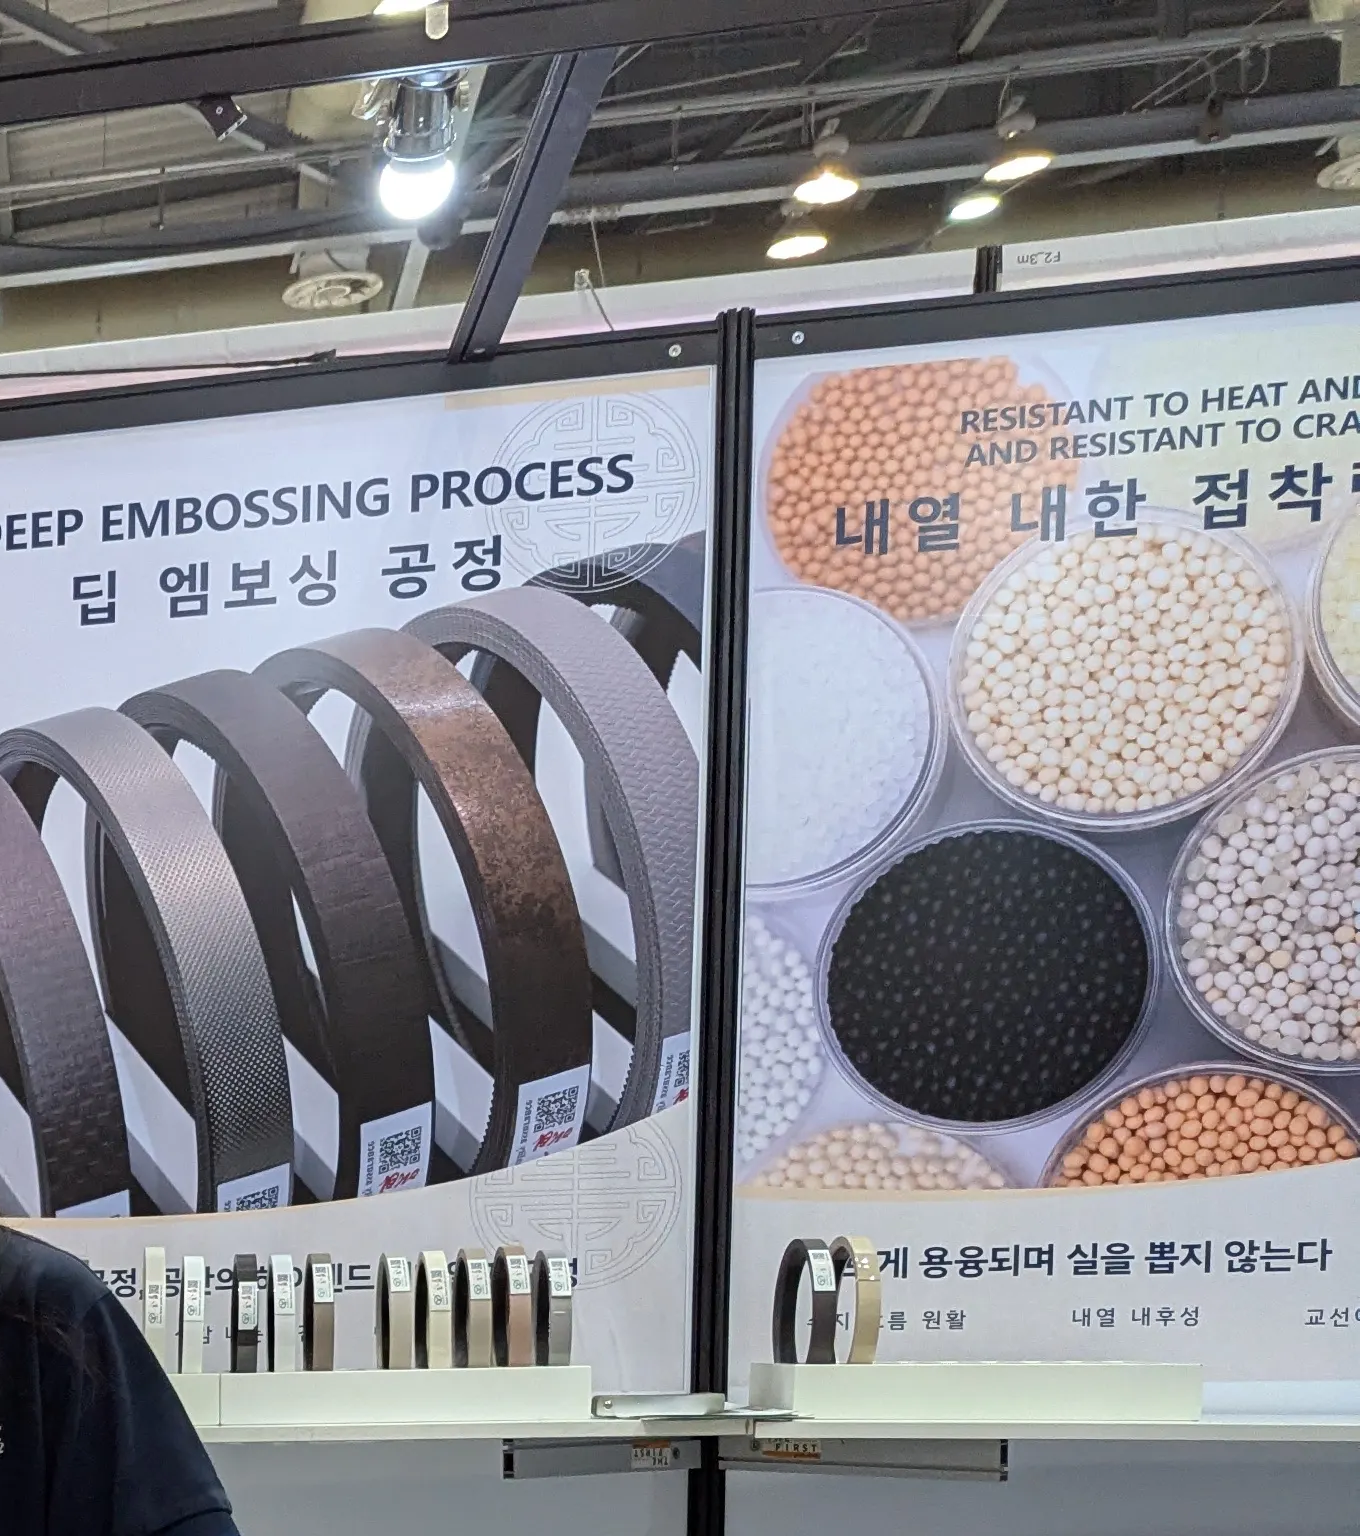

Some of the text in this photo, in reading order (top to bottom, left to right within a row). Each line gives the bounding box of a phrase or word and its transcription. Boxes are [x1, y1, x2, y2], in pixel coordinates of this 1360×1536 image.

[1016, 250, 1061, 267] F2_3m
[961, 396, 1134, 435] RESISTANT
[1147, 391, 1189, 417] TO
[1201, 381, 1289, 413] HEAT
[964, 439, 1039, 469] AND
[1050, 421, 1226, 461] RESISTANT
[1236, 417, 1282, 445] TO
[101, 477, 390, 543] EMBOSSING
[409, 453, 635, 514] PROCESS
[835, 461, 1360, 556] 내열 내한 접착
[70, 533, 505, 627] 딥 엠보싱 공정
[917, 1244, 1055, 1278] 용융되며
[1067, 1241, 1135, 1276] 실을
[1144, 1240, 1212, 1275] 뽑지
[1223, 1237, 1332, 1274] 않는다
[921, 1308, 967, 1331] 원활
[1071, 1305, 1201, 1329] 내열 내후성
[774, 1442, 819, 1453] FIRST
